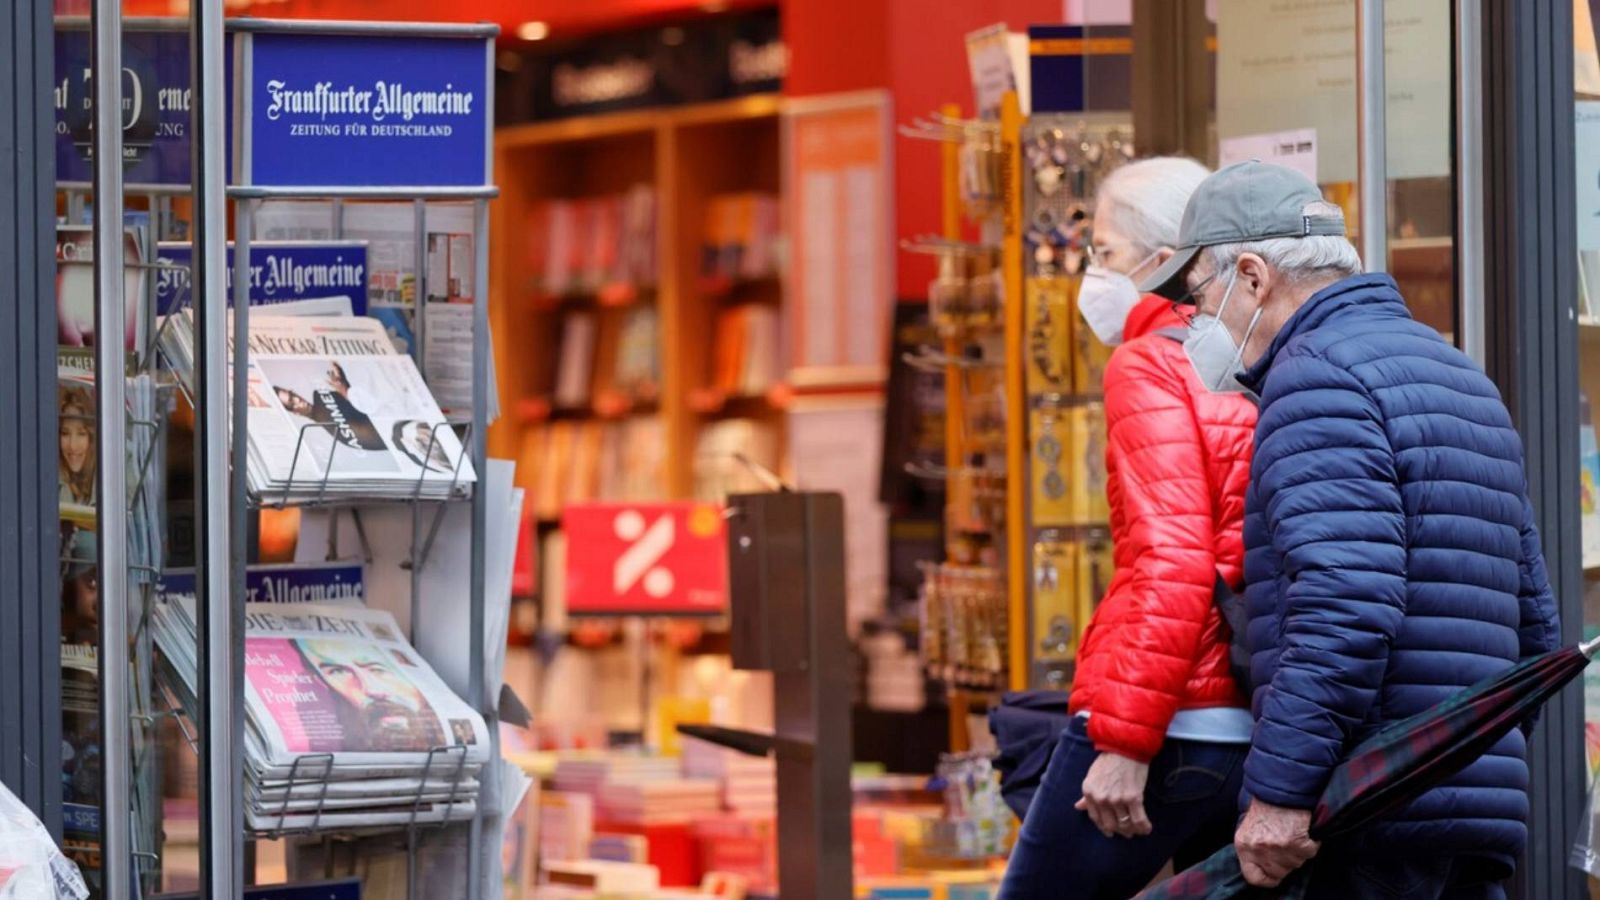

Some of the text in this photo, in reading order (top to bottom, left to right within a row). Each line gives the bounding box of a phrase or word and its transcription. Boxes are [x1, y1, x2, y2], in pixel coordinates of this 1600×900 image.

[266, 79, 473, 121] Frankfurter Allgemeine
[290, 121, 452, 137] ZEITUNG FÜR DEUTSCHLAND
[264, 256, 364, 295] Allgemeine
[261, 686, 319, 708] Prophet
